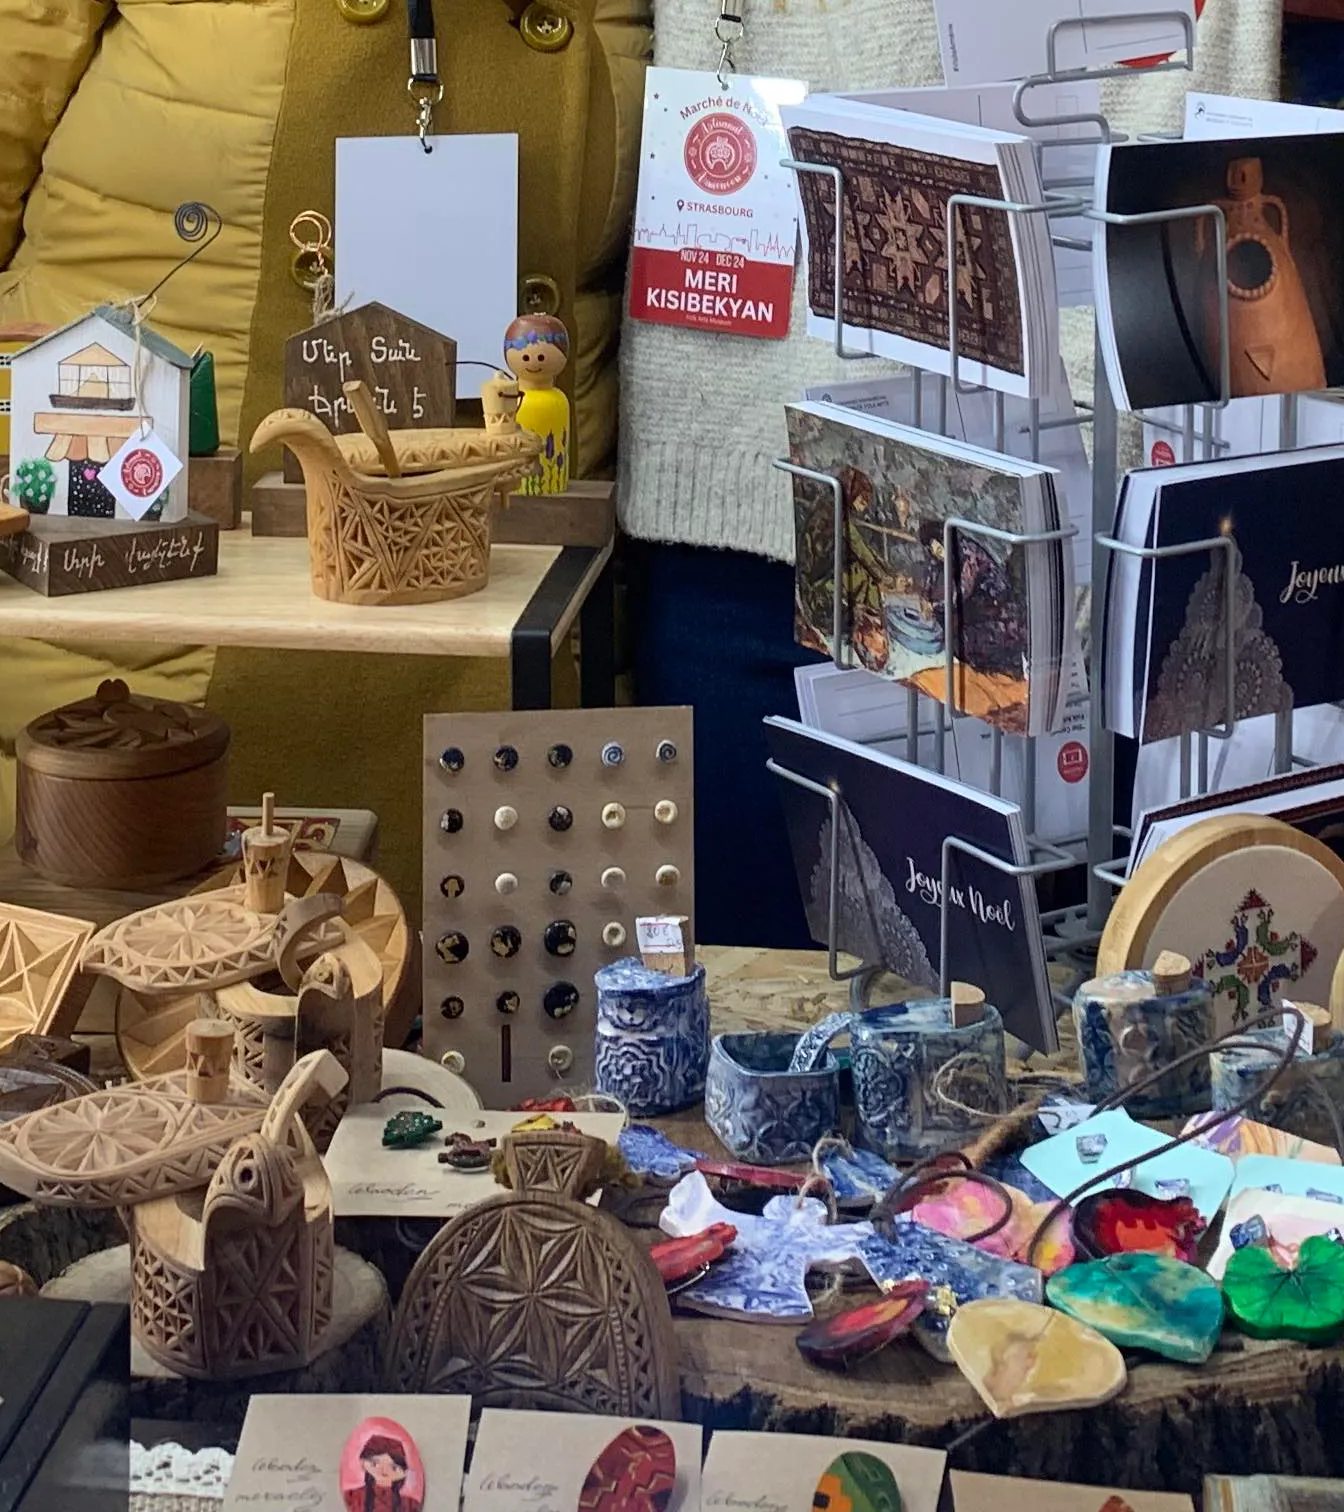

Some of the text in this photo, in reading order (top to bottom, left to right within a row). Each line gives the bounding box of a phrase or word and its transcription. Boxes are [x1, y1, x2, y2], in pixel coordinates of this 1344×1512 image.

[679, 96, 723, 120] Marché
[725, 96, 741, 110] de
[687, 201, 754, 218] STRASBOURG
[680, 249, 745, 269] NOV 24 DEC 24
[685, 269, 738, 295] MERI
[646, 287, 774, 323] KISIBEKYAN
[302, 336, 422, 383] Մեր Տան
[968, 884, 1016, 932] Noël
